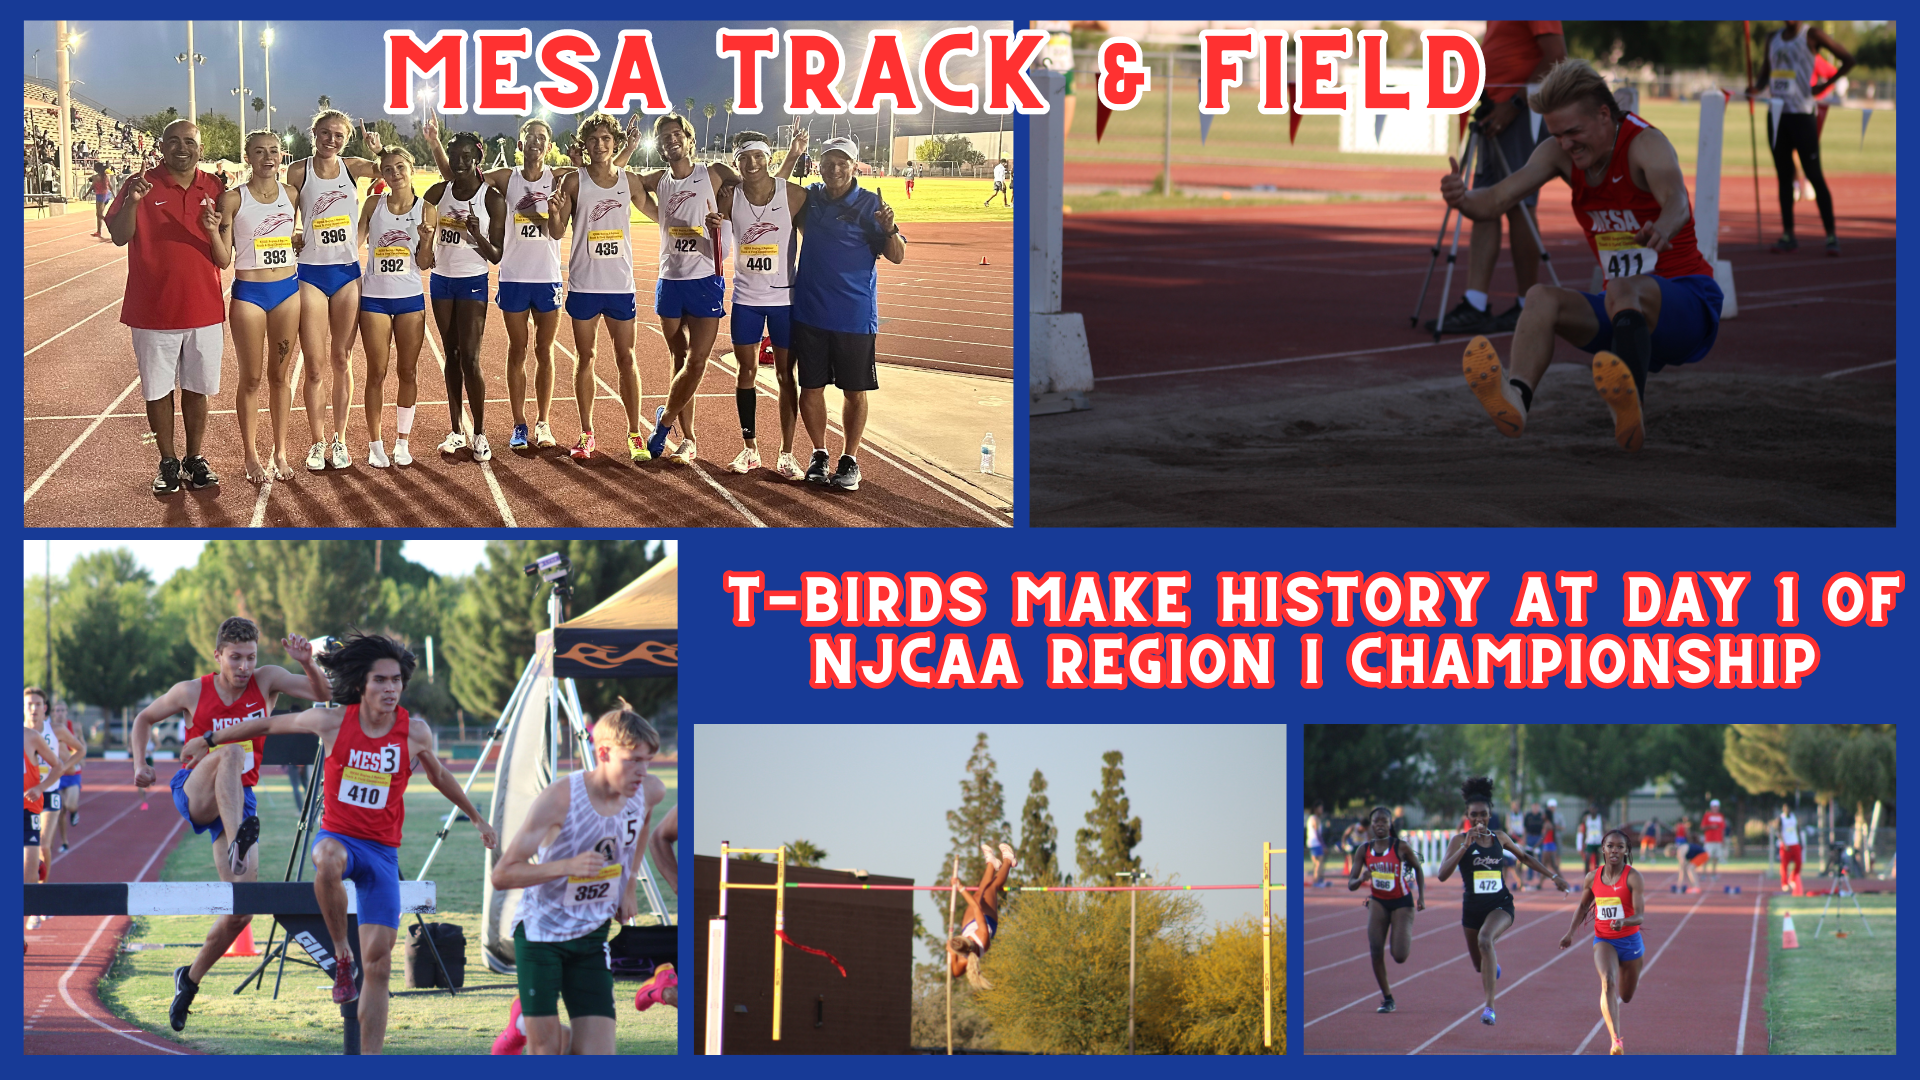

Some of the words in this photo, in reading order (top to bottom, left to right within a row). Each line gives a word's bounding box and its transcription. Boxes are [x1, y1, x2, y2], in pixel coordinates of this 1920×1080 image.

[321, 228, 346, 244] 396
[441, 229, 460, 244] 390
[521, 225, 542, 238] 421
[595, 242, 619, 256] 435
[674, 239, 697, 252] 422
[263, 250, 287, 265] 393
[746, 257, 772, 271] 440
[1608, 253, 1643, 277] 411
[380, 259, 404, 273] 392
[348, 748, 382, 773] MES
[384, 748, 396, 772] 3
[347, 785, 380, 805] 410
[625, 819, 638, 846] 5
[575, 882, 610, 901] 352
[1479, 880, 1498, 891] 472
[1601, 907, 1618, 918] 407
[294, 930, 337, 971] GILL
